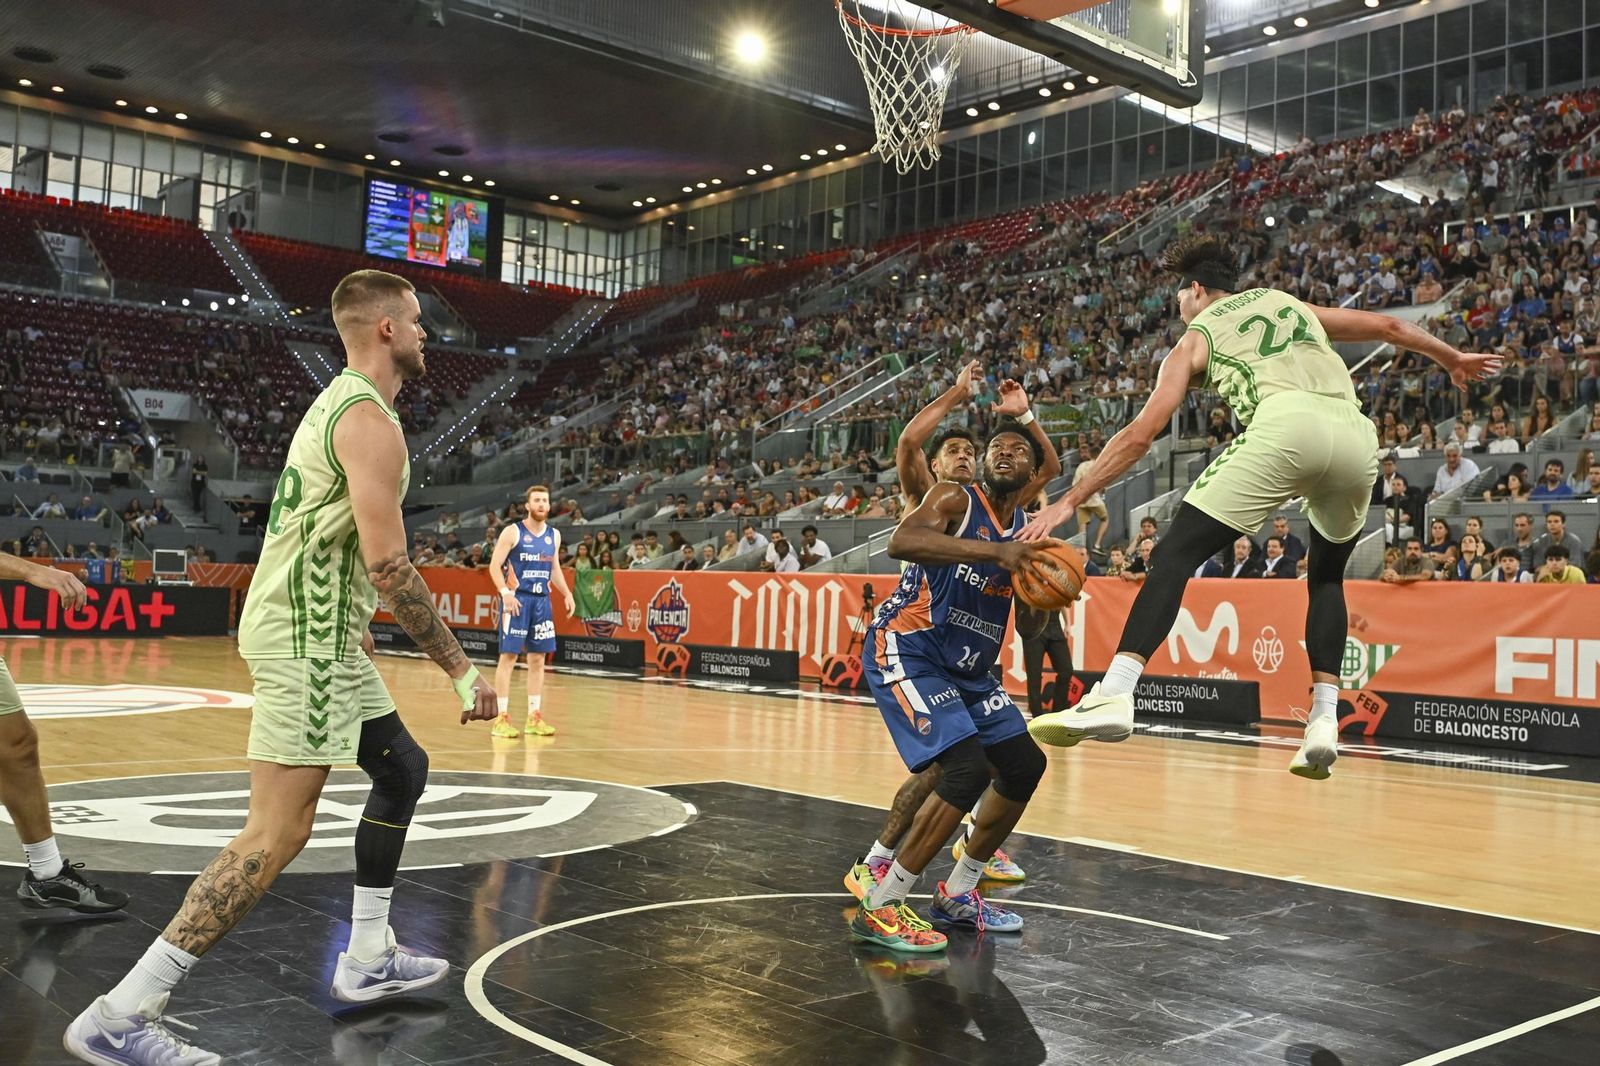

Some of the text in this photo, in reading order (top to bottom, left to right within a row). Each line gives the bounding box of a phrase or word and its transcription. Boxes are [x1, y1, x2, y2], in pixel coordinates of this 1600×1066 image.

[1210, 306, 1228, 318] DE
[1237, 305, 1317, 358] 22
[144, 398, 164, 409] B04
[532, 582, 543, 594] 16
[649, 608, 688, 626] PALENCIA
[565, 640, 620, 653] FEDERACIÓN ESPAÑOLA
[572, 651, 604, 662] BALONCESTO
[701, 652, 771, 667] FEDERACIÓN ESPAÑOLA
[848, 656, 860, 672] FEB
[956, 645, 981, 671] 24
[701, 664, 750, 677] DE BALONCESTO
[1133, 681, 1219, 700] ACIÓN ESPAÑOLA
[1133, 698, 1184, 713] ONCESTO
[1356, 693, 1380, 716] FEB
[1414, 701, 1580, 729] FEDERACIÓN ESPAÑOLA
[1414, 718, 1529, 743] DE BALONCESTO
